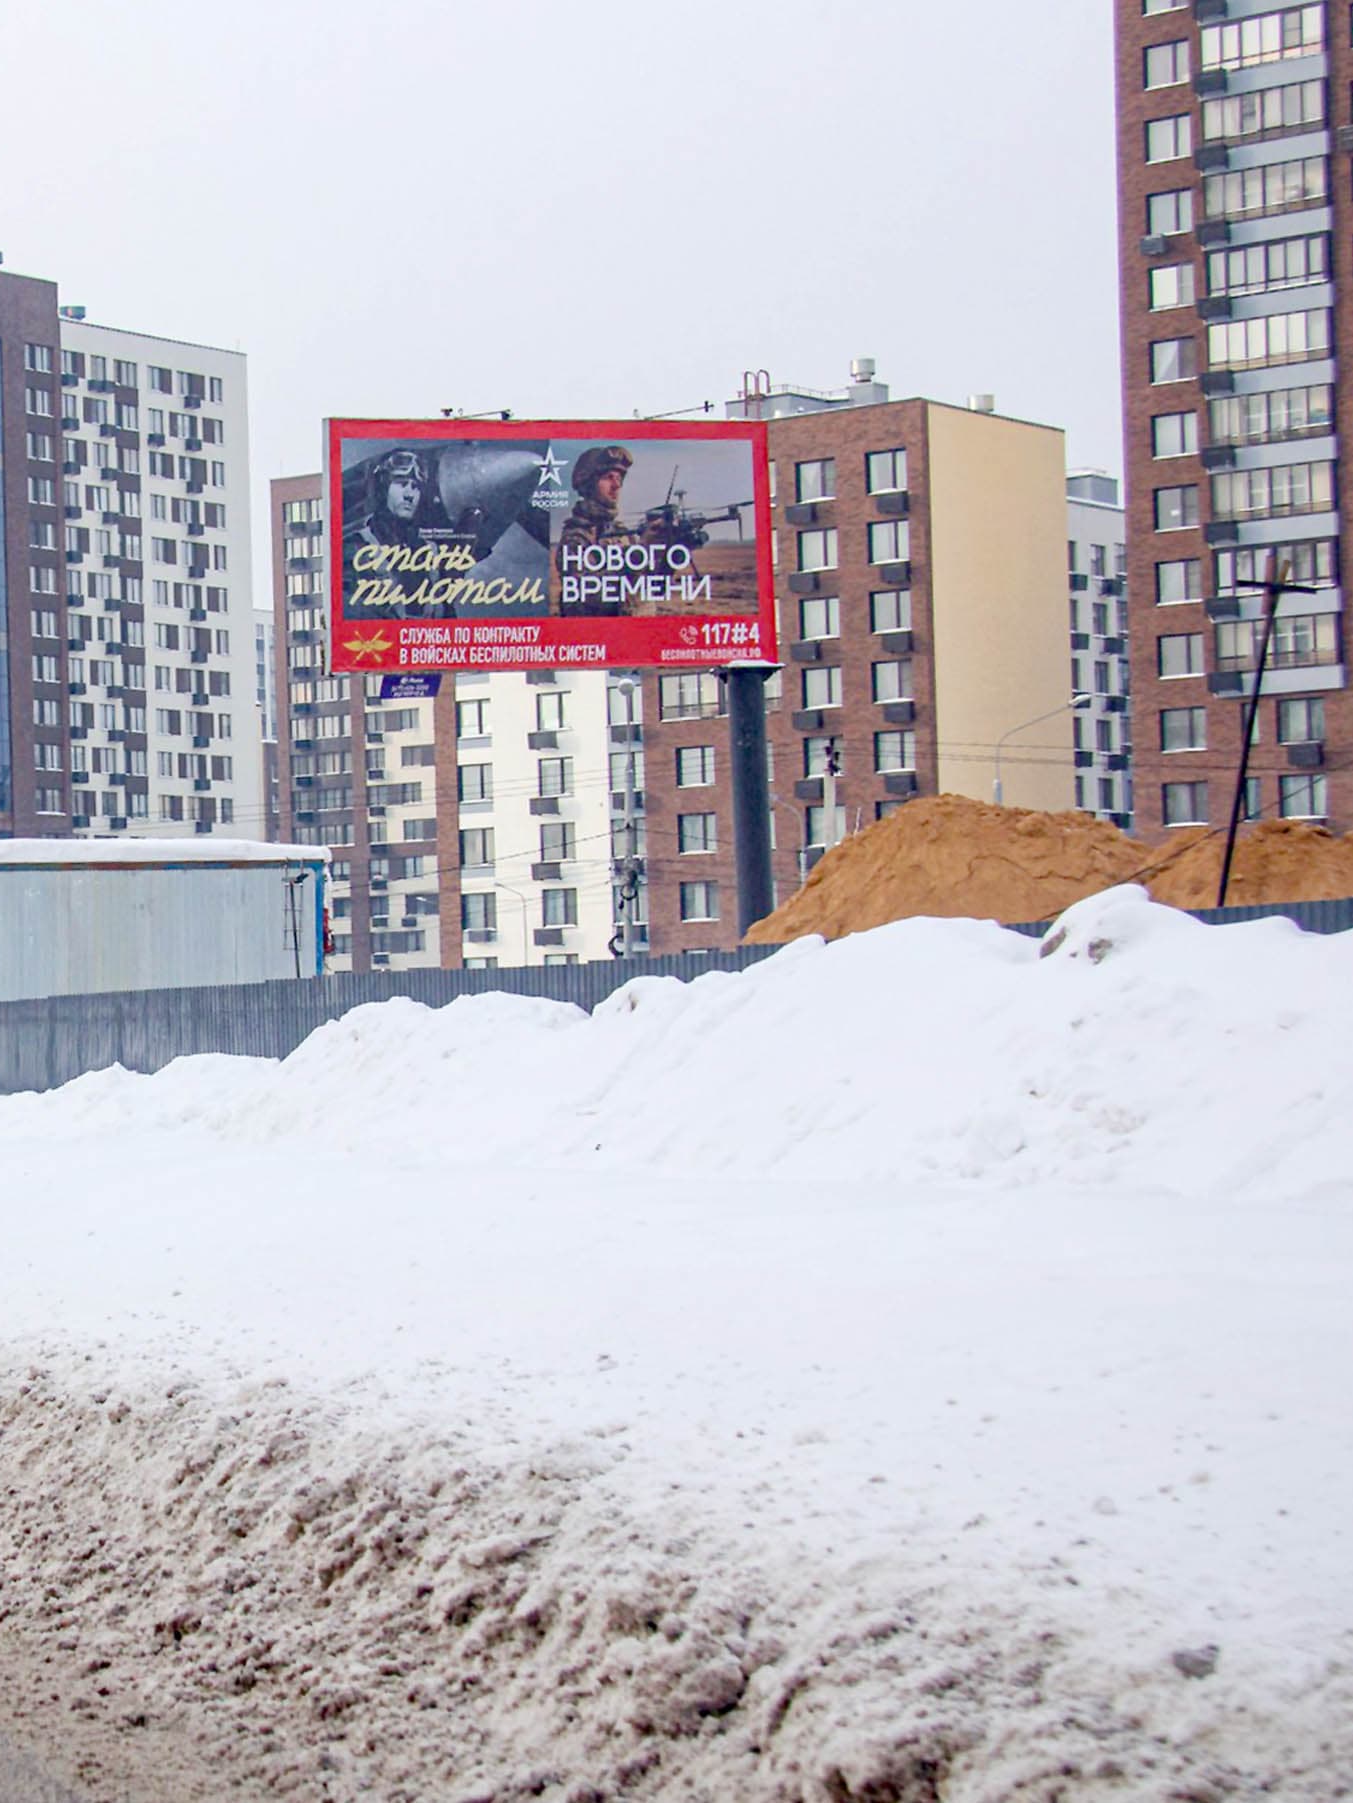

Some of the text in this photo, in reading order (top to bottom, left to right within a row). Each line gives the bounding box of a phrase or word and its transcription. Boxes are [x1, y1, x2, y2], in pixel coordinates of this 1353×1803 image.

[531, 499, 569, 508] РОССИИ
[532, 491, 569, 499] АРМИЯ
[352, 544, 477, 572] стань
[562, 544, 691, 571] НОВОГО
[349, 577, 545, 606] пилотом
[562, 574, 712, 603] ВРЕМЕНИ
[399, 625, 541, 645] СЛУЖБА ПО КОНТРАКТУ
[701, 622, 760, 645] 117#4
[399, 644, 607, 664] В ВОЙСКАХ БЕСПИЛОТНЫХ СИСТЕМ
